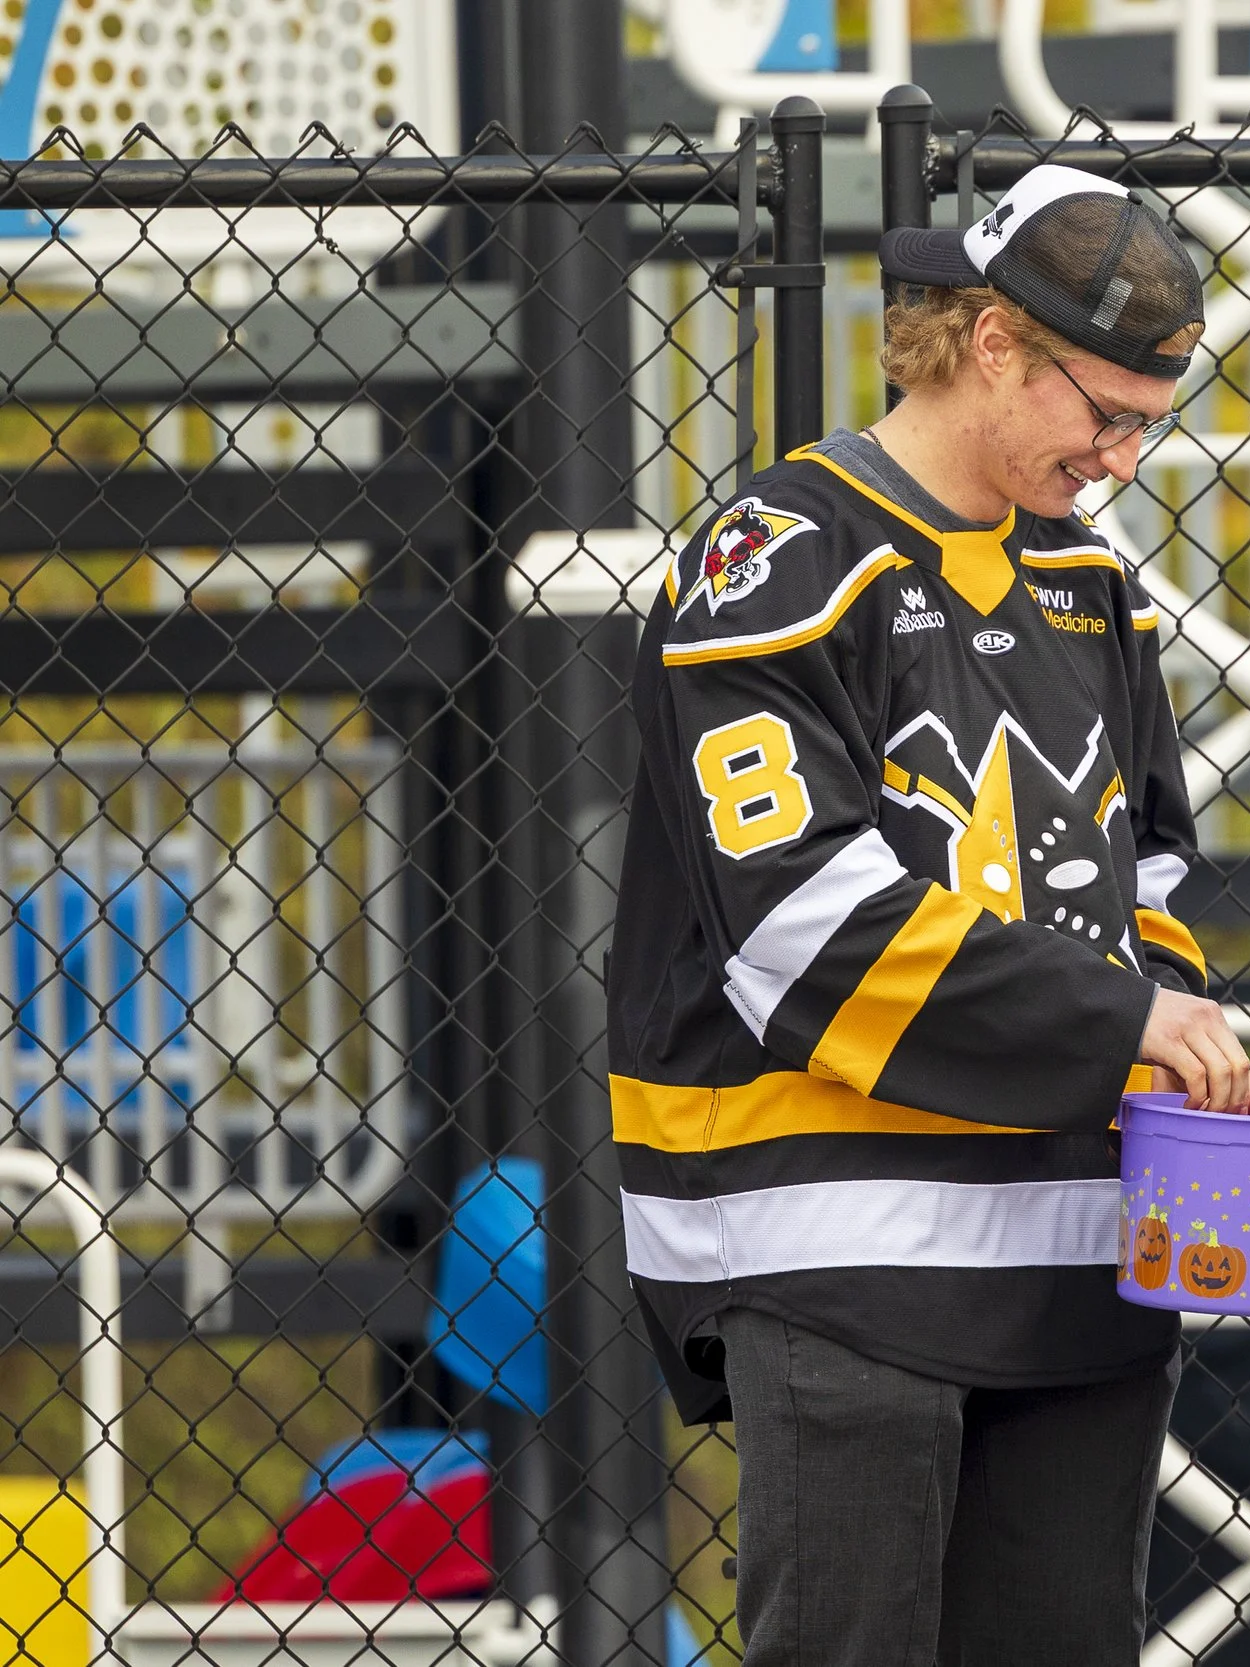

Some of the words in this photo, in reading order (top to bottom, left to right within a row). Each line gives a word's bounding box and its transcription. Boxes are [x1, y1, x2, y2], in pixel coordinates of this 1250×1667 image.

[1035, 586, 1073, 610] WVU
[892, 609, 945, 635] esBanco
[1042, 606, 1106, 634] Medicine
[692, 711, 814, 860] 8
